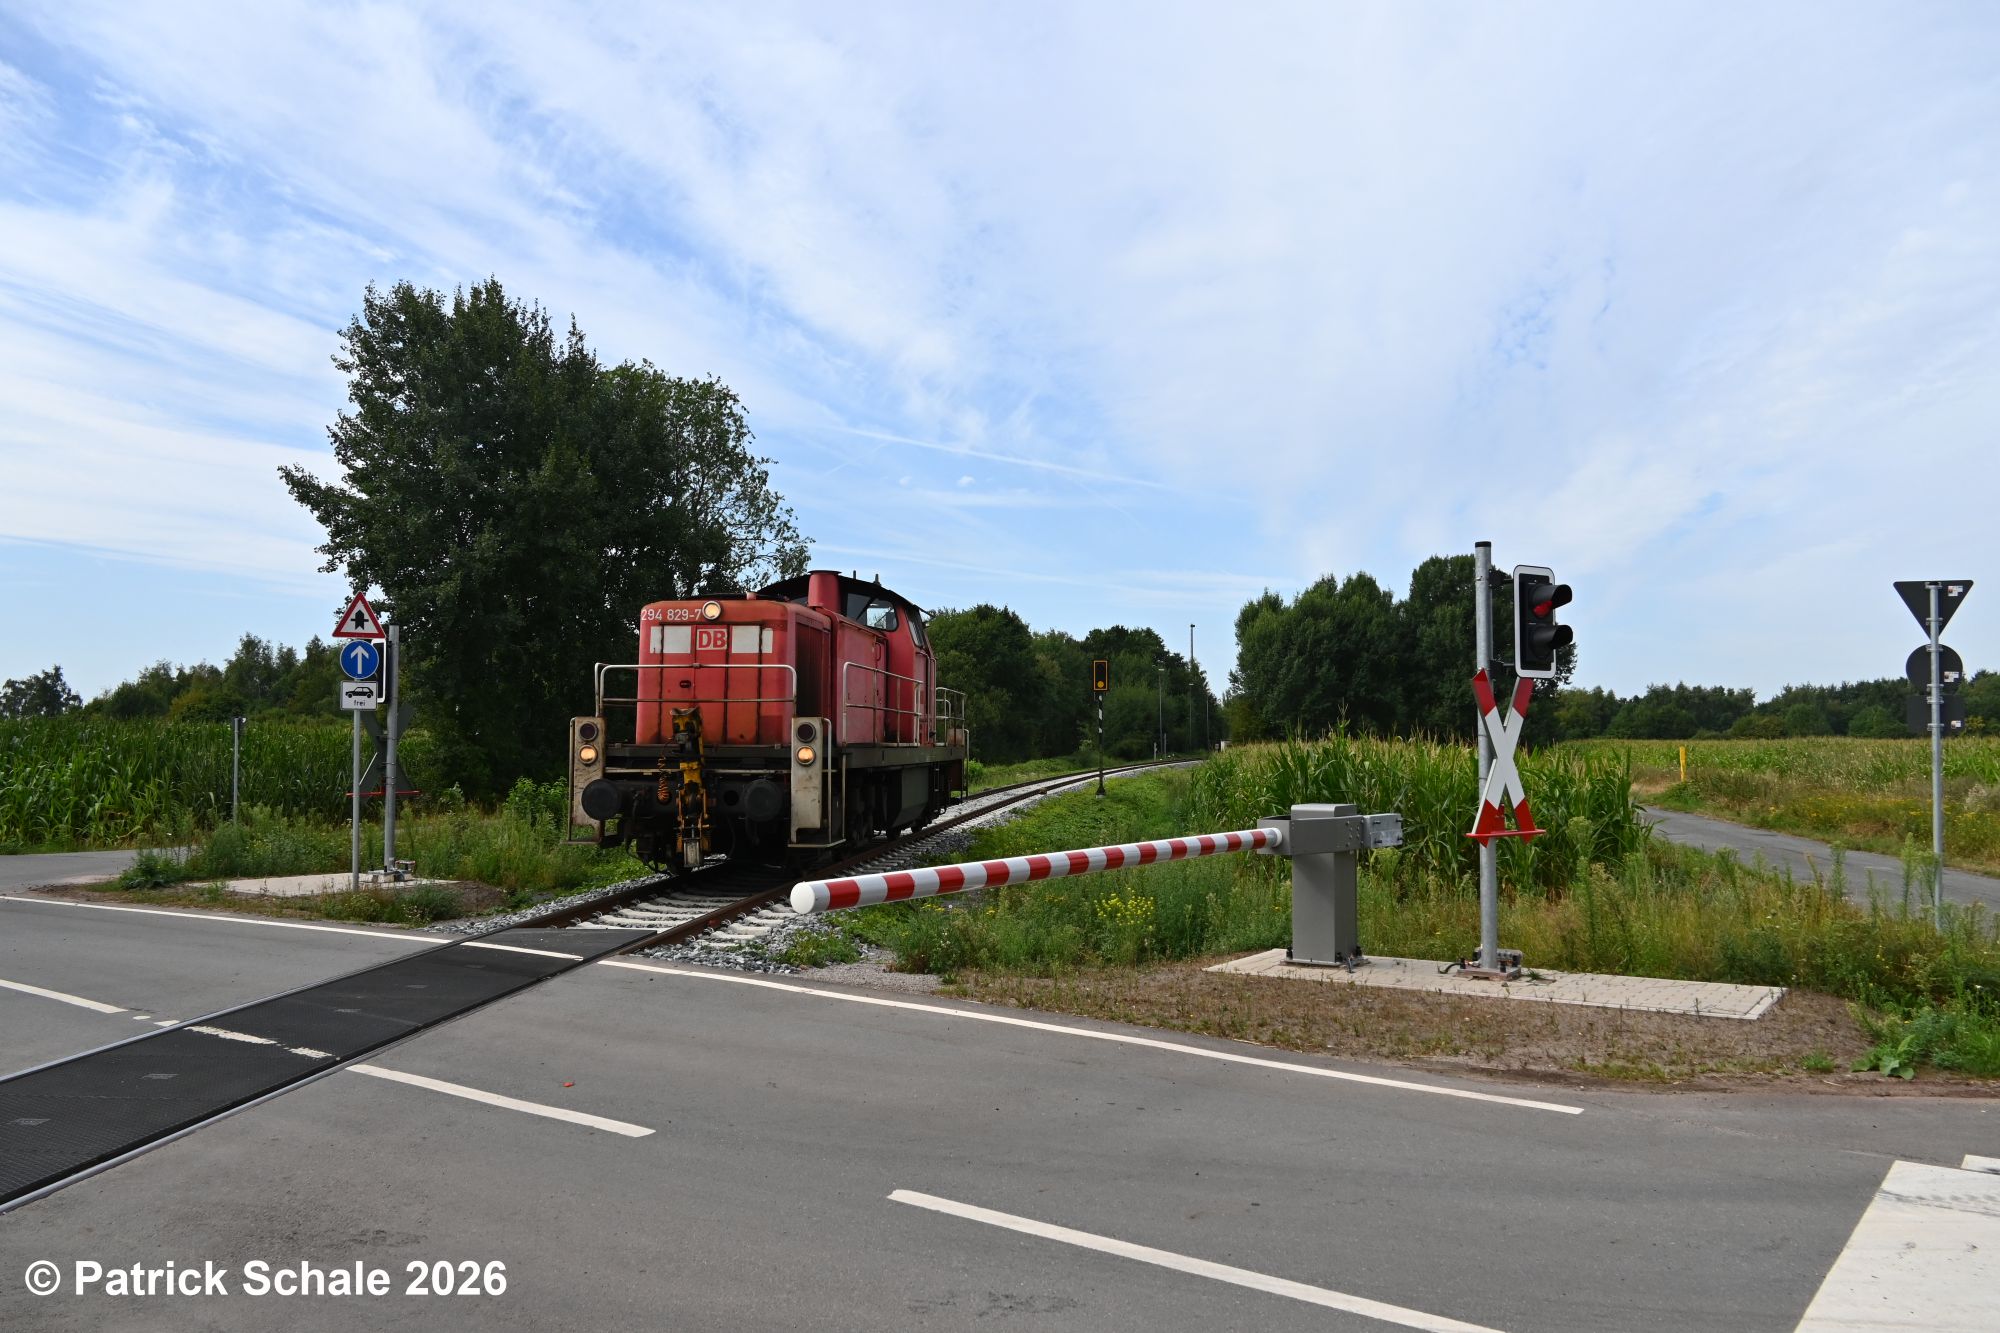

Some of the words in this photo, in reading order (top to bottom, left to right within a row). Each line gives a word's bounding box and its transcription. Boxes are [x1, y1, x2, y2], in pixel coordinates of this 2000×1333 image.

[641, 609, 662, 621] 294
[667, 609, 701, 621] 829-7
[698, 631, 726, 648] DB
